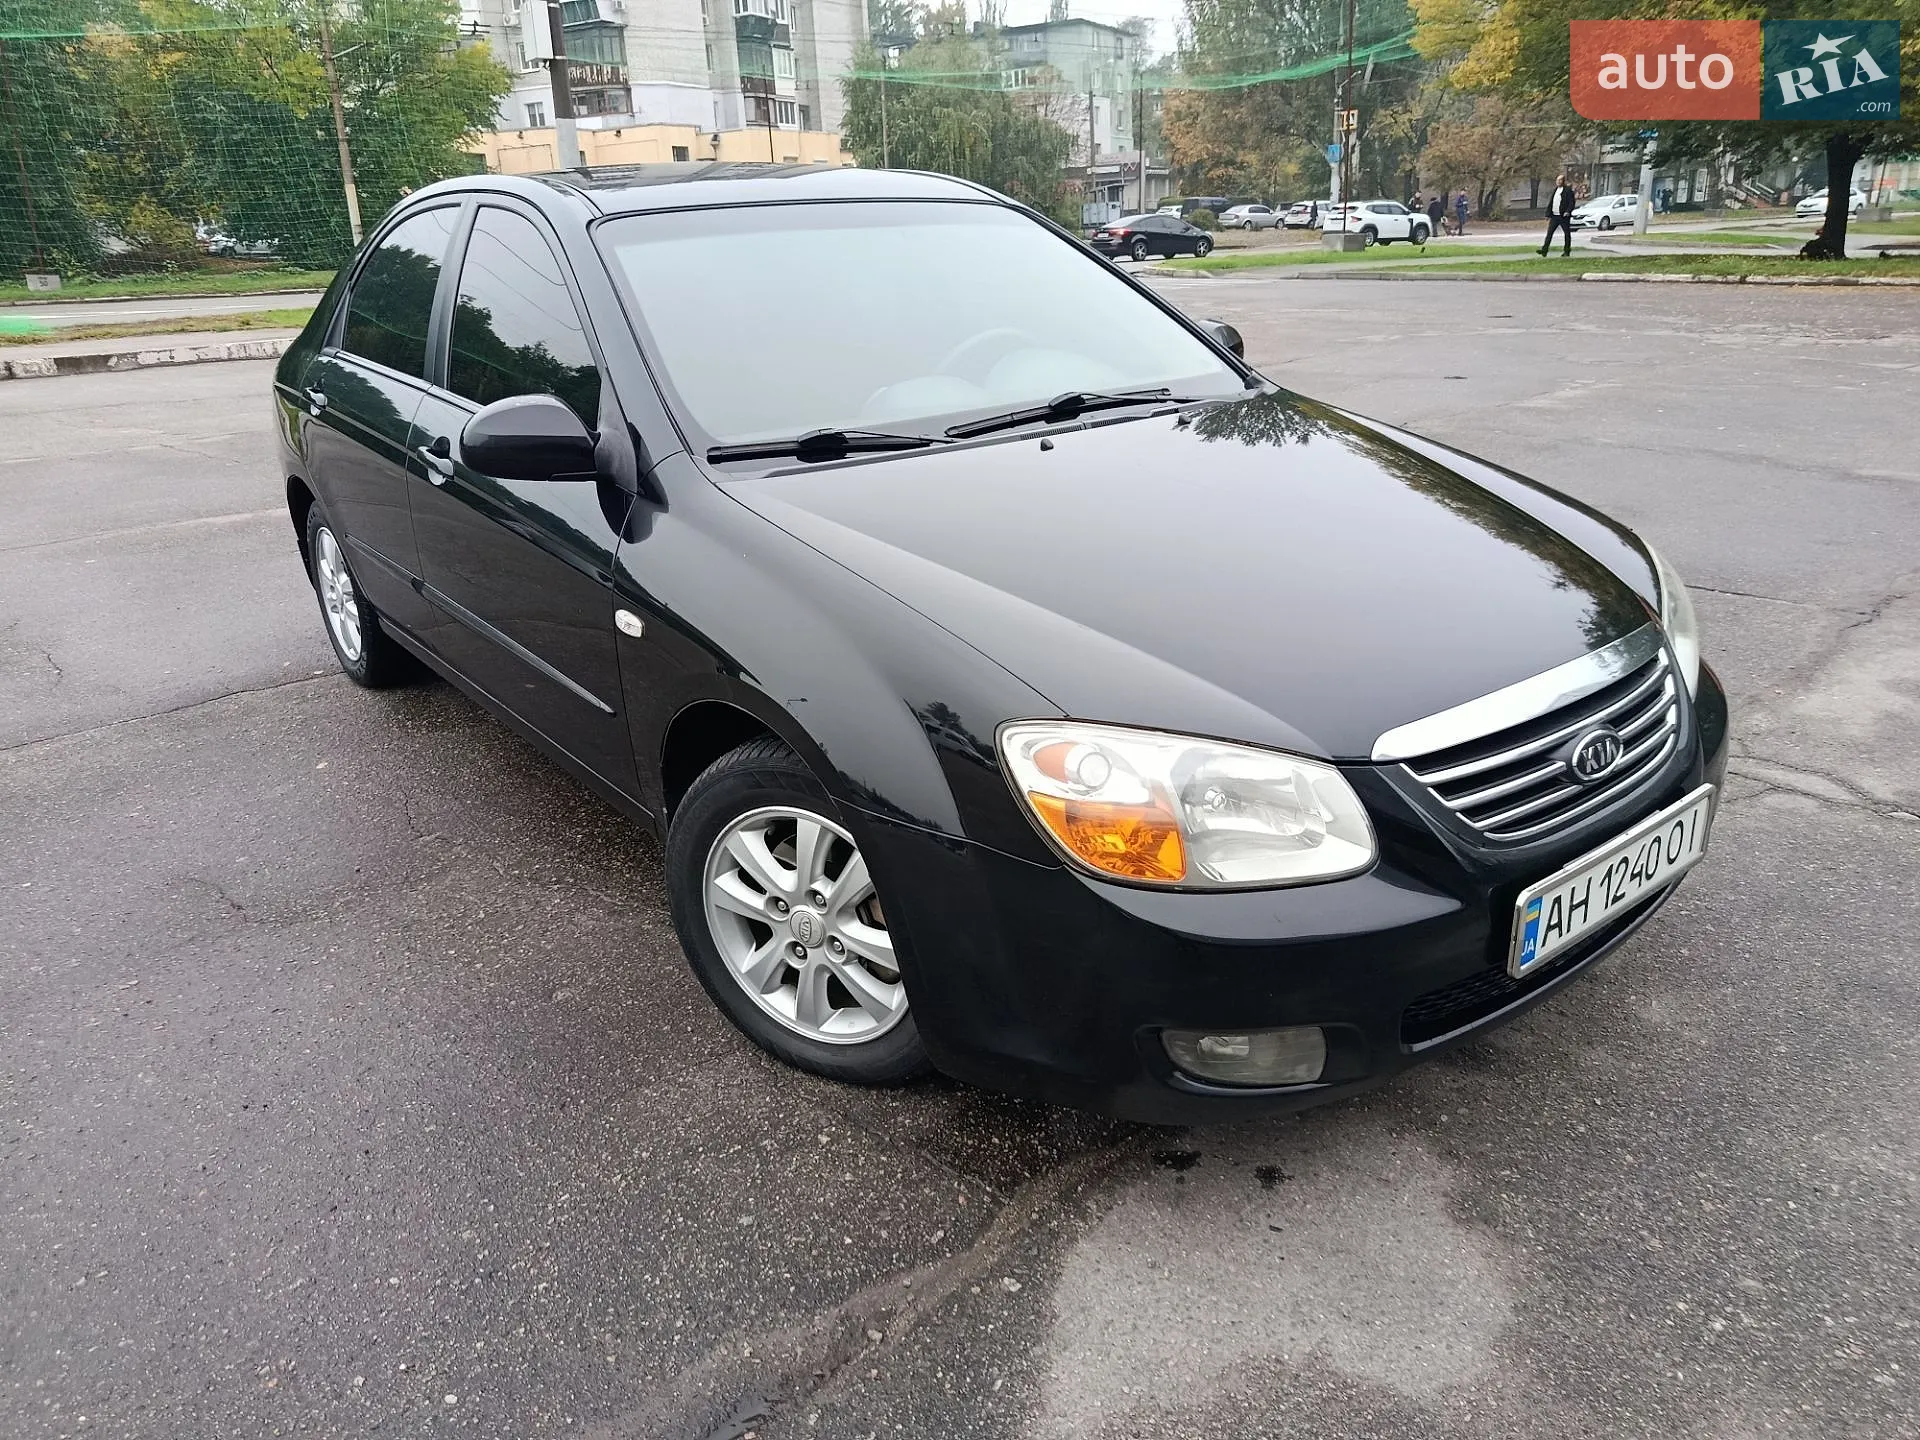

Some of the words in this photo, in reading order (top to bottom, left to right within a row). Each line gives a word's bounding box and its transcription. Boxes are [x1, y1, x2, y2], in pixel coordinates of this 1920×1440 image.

[1581, 737, 1617, 774] KIA
[1541, 877, 1592, 948] AH
[1600, 836, 1661, 909] 1240
